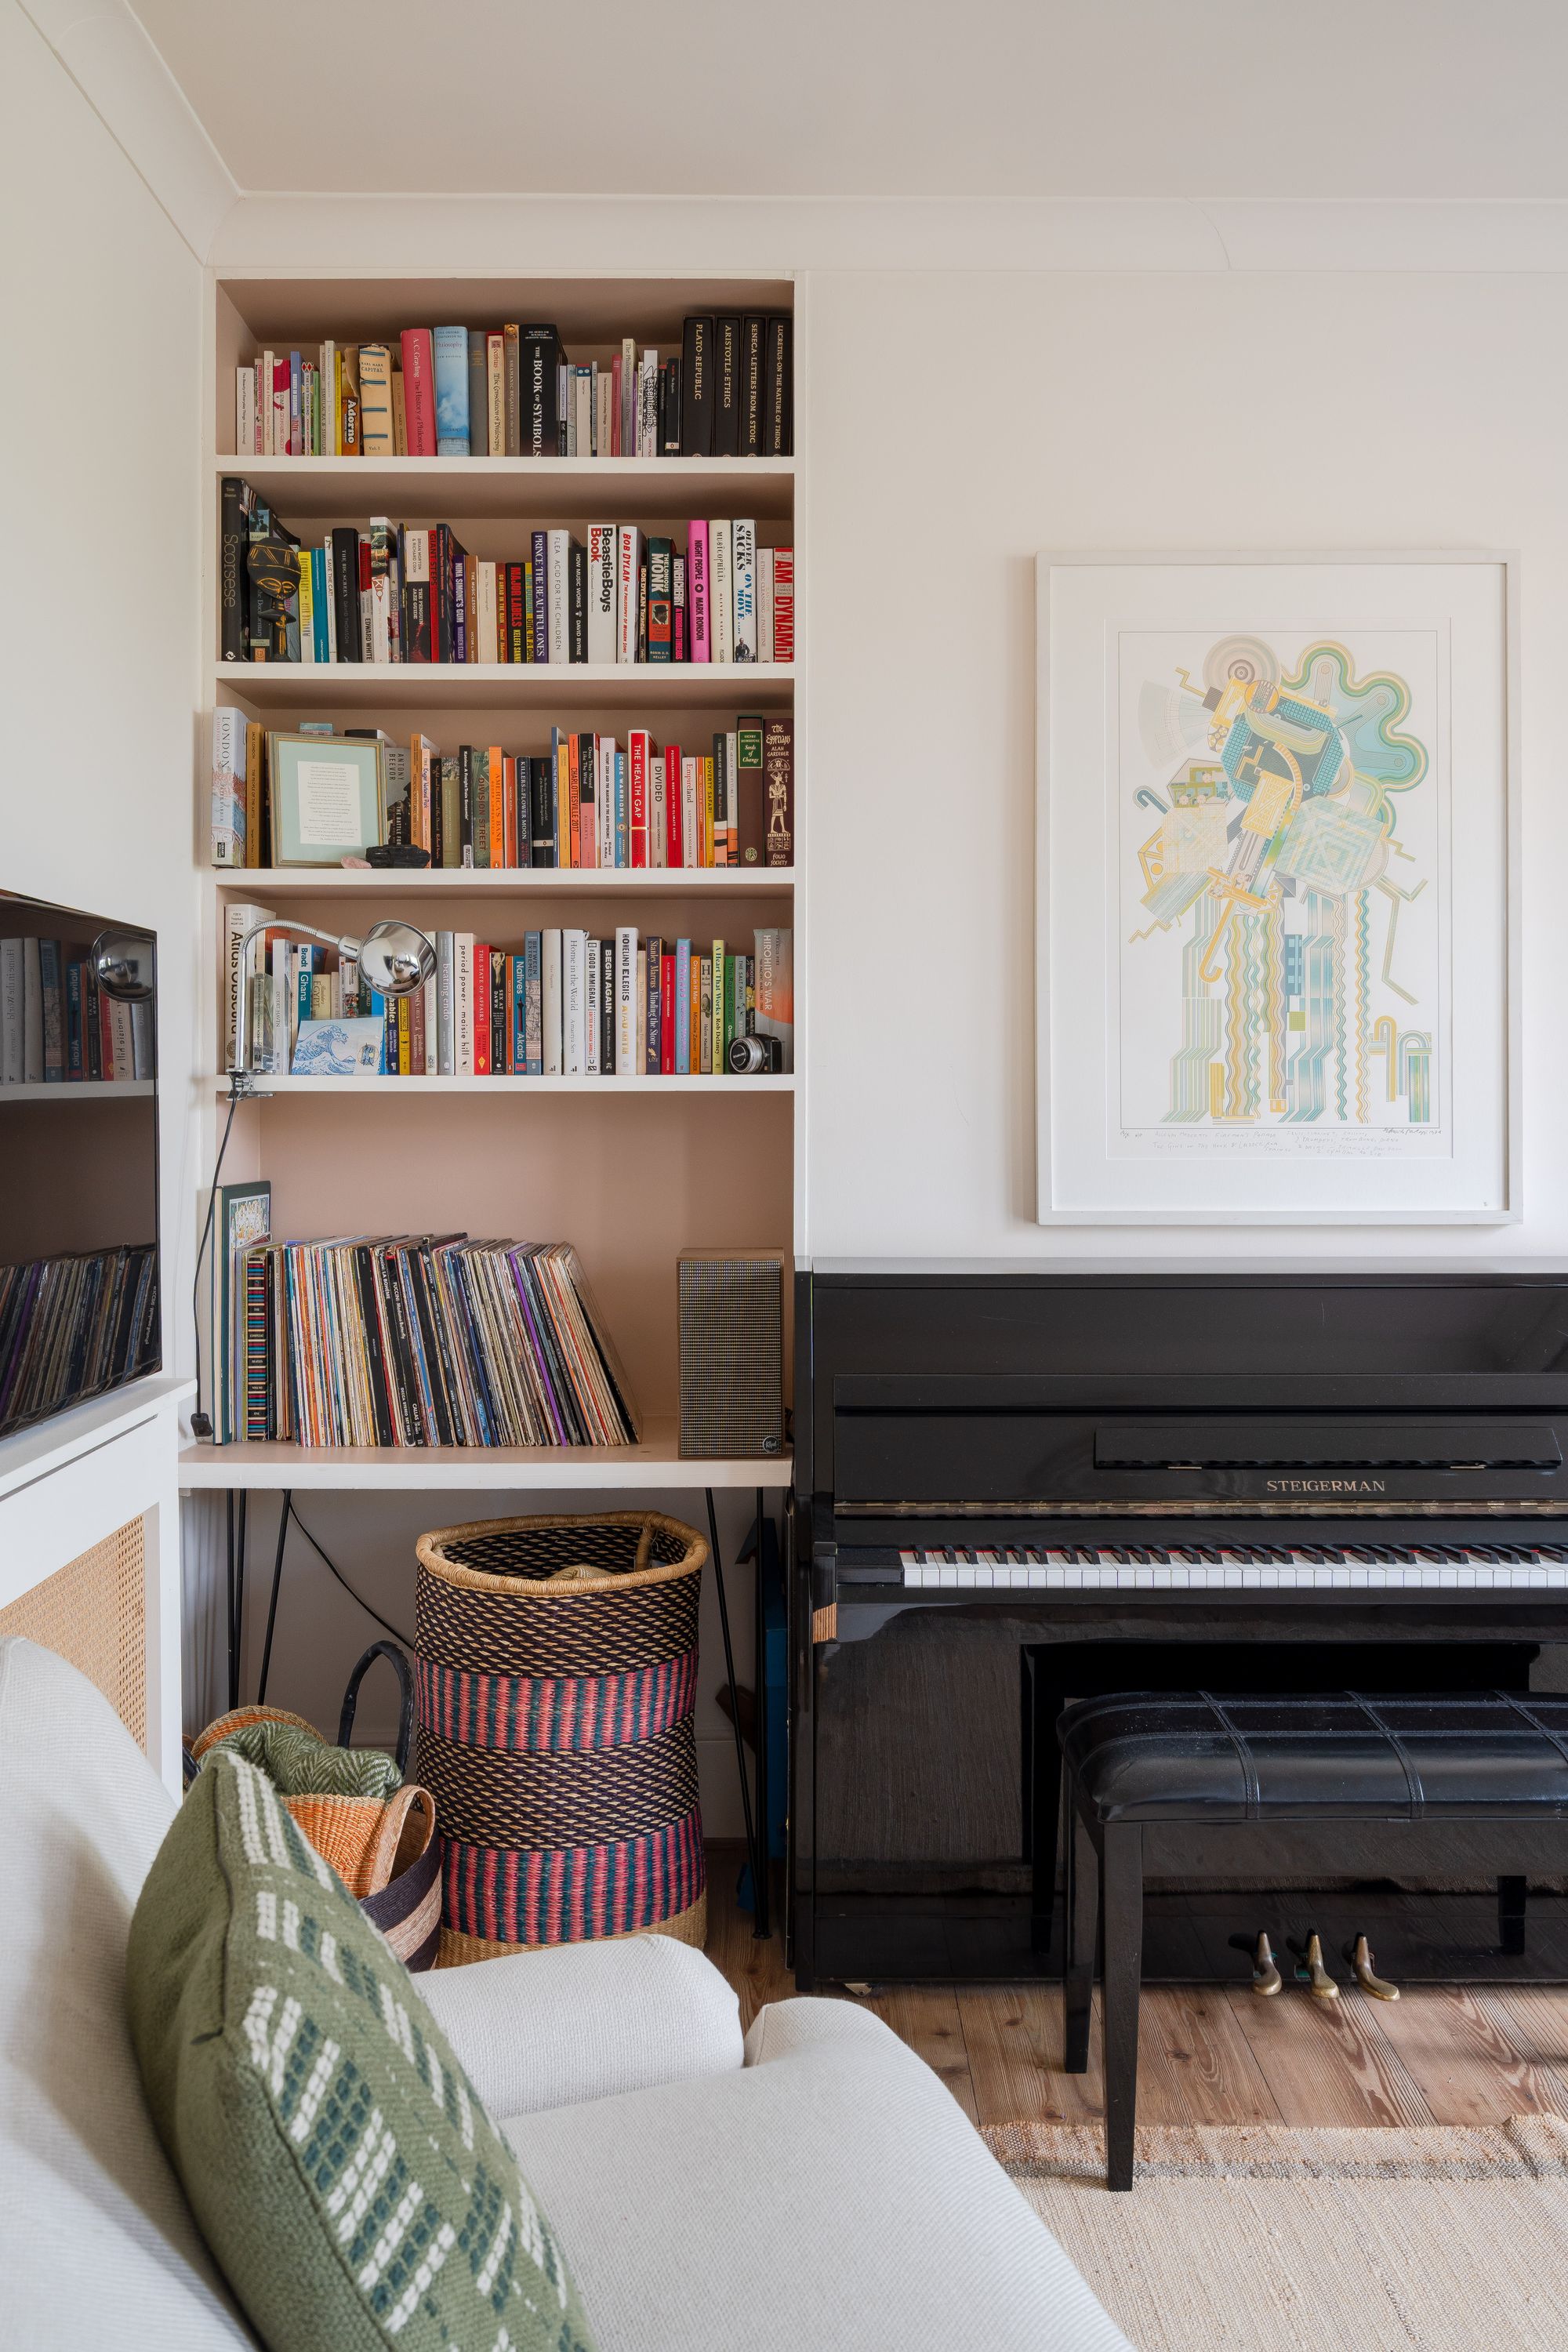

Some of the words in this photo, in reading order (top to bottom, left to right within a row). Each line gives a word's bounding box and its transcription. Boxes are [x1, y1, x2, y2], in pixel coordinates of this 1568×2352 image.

[533, 359, 543, 393] BOOK
[535, 394, 539, 403] OF
[646, 379, 655, 425] essentialism
[347, 399, 357, 444] Adorno
[533, 403, 543, 457] SYMBOLS
[775, 415, 781, 423] OF
[535, 535, 543, 565] PRINCE
[590, 528, 601, 563] Book
[695, 539, 703, 557] NIGHT
[736, 524, 746, 571] SACKS
[224, 534, 238, 608] Scorsese
[455, 563, 463, 577] NINA
[510, 567, 521, 596] MAJOR
[535, 566, 544, 585] THE
[652, 553, 663, 593] MONK
[695, 559, 703, 580] PEOPLE
[745, 573, 752, 589] ON
[455, 579, 464, 608] SIMONE'S
[674, 582, 684, 606] CHERRY
[511, 597, 522, 627] LABELS
[535, 586, 544, 633] BEAUTIFUL
[222, 717, 230, 768] LONDON
[684, 764, 693, 803] Empireland
[459, 946, 469, 973] period
[702, 964, 710, 975] H
[763, 935, 772, 986] HIROHITO'S
[441, 963, 451, 996] beating
[479, 985, 485, 994] OF
[1267, 1480, 1385, 1492] STEIGERMAN
